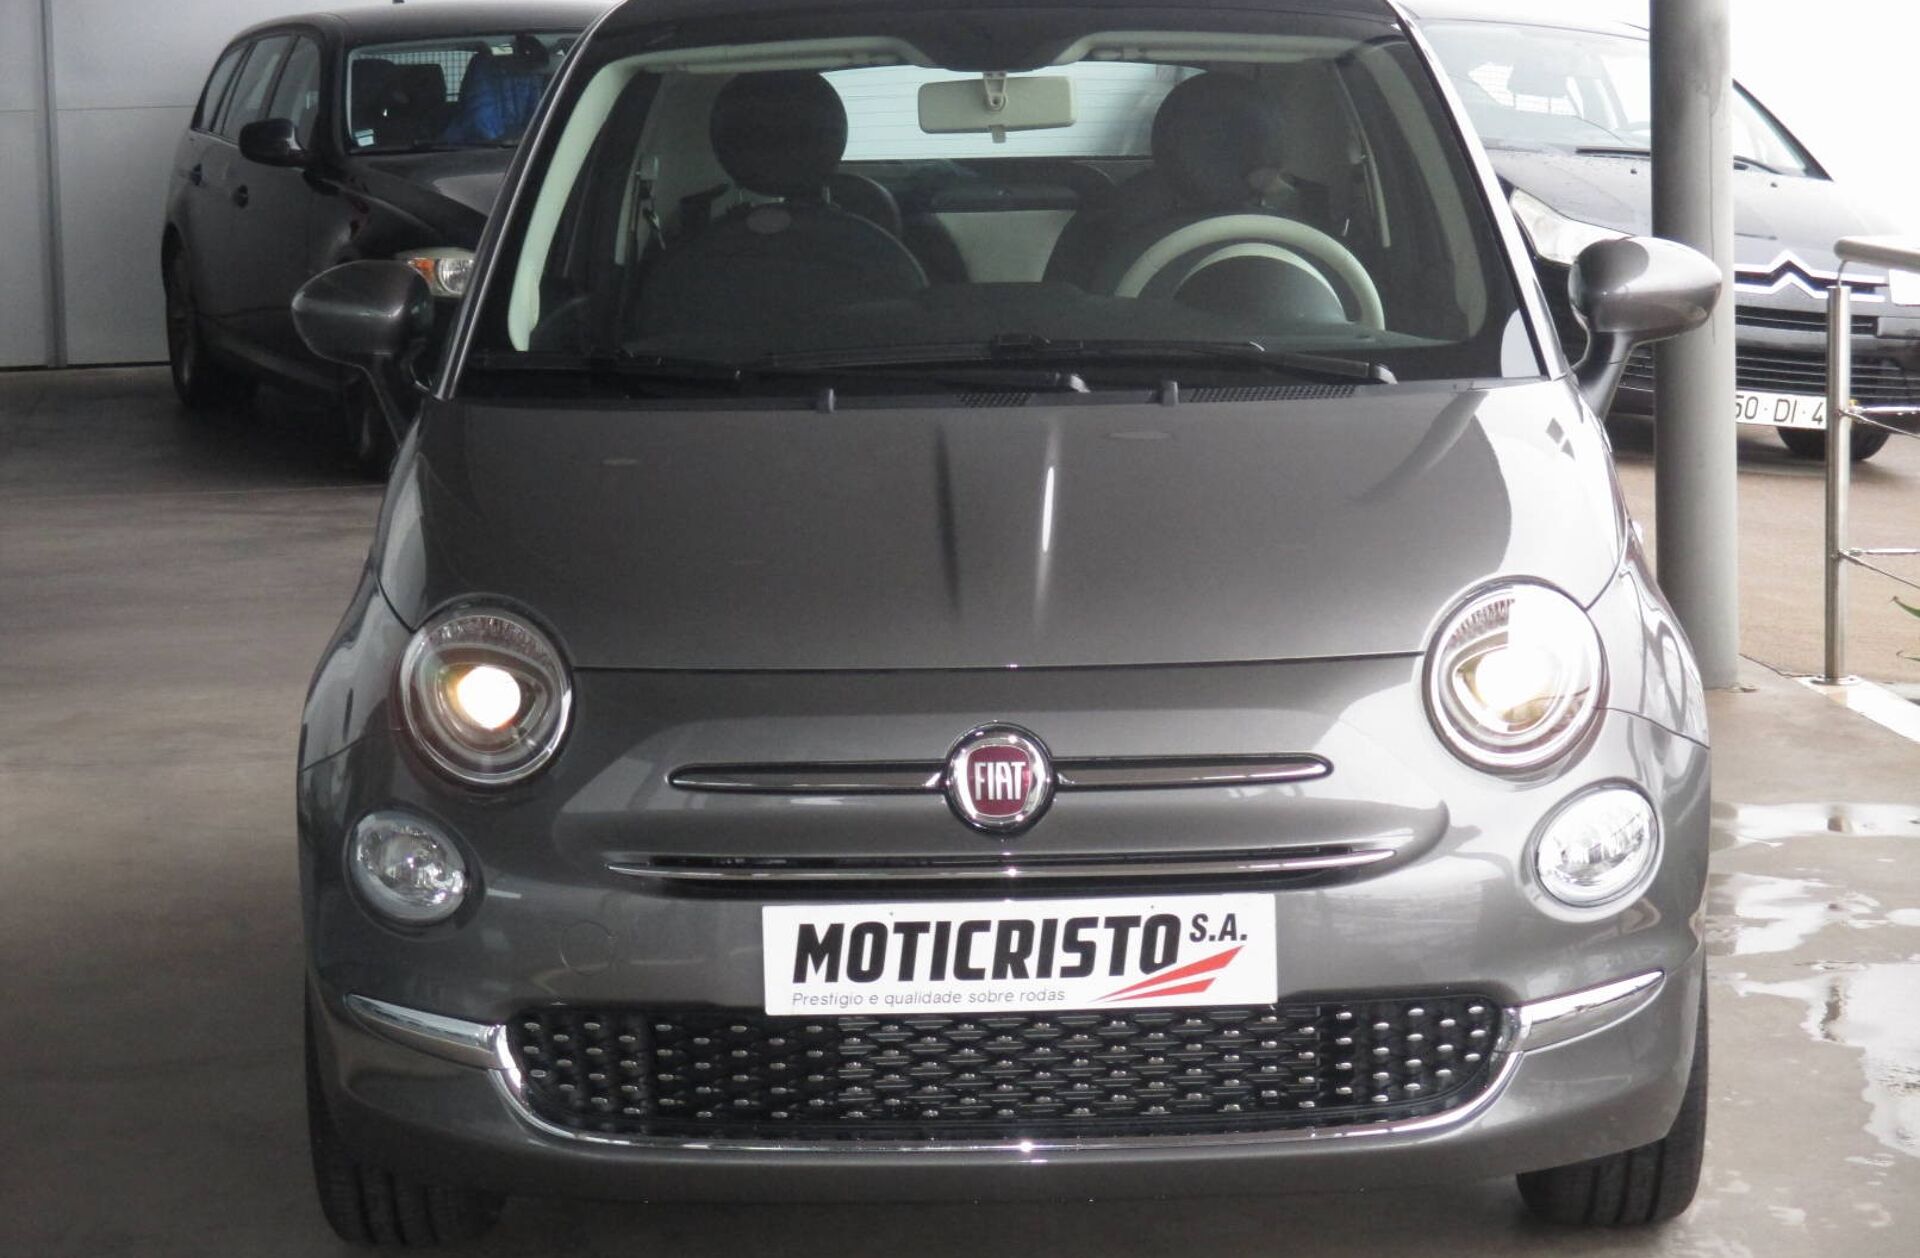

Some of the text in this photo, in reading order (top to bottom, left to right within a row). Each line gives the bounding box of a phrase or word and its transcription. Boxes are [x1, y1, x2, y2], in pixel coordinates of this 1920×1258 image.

[974, 761, 1026, 801] FIAT
[792, 912, 1248, 984] MOTICRISTO S.A.
[868, 994, 879, 1005] e
[884, 990, 962, 1008] qualidade
[967, 989, 1015, 1004] sobre
[1019, 988, 1066, 1002] rodas
